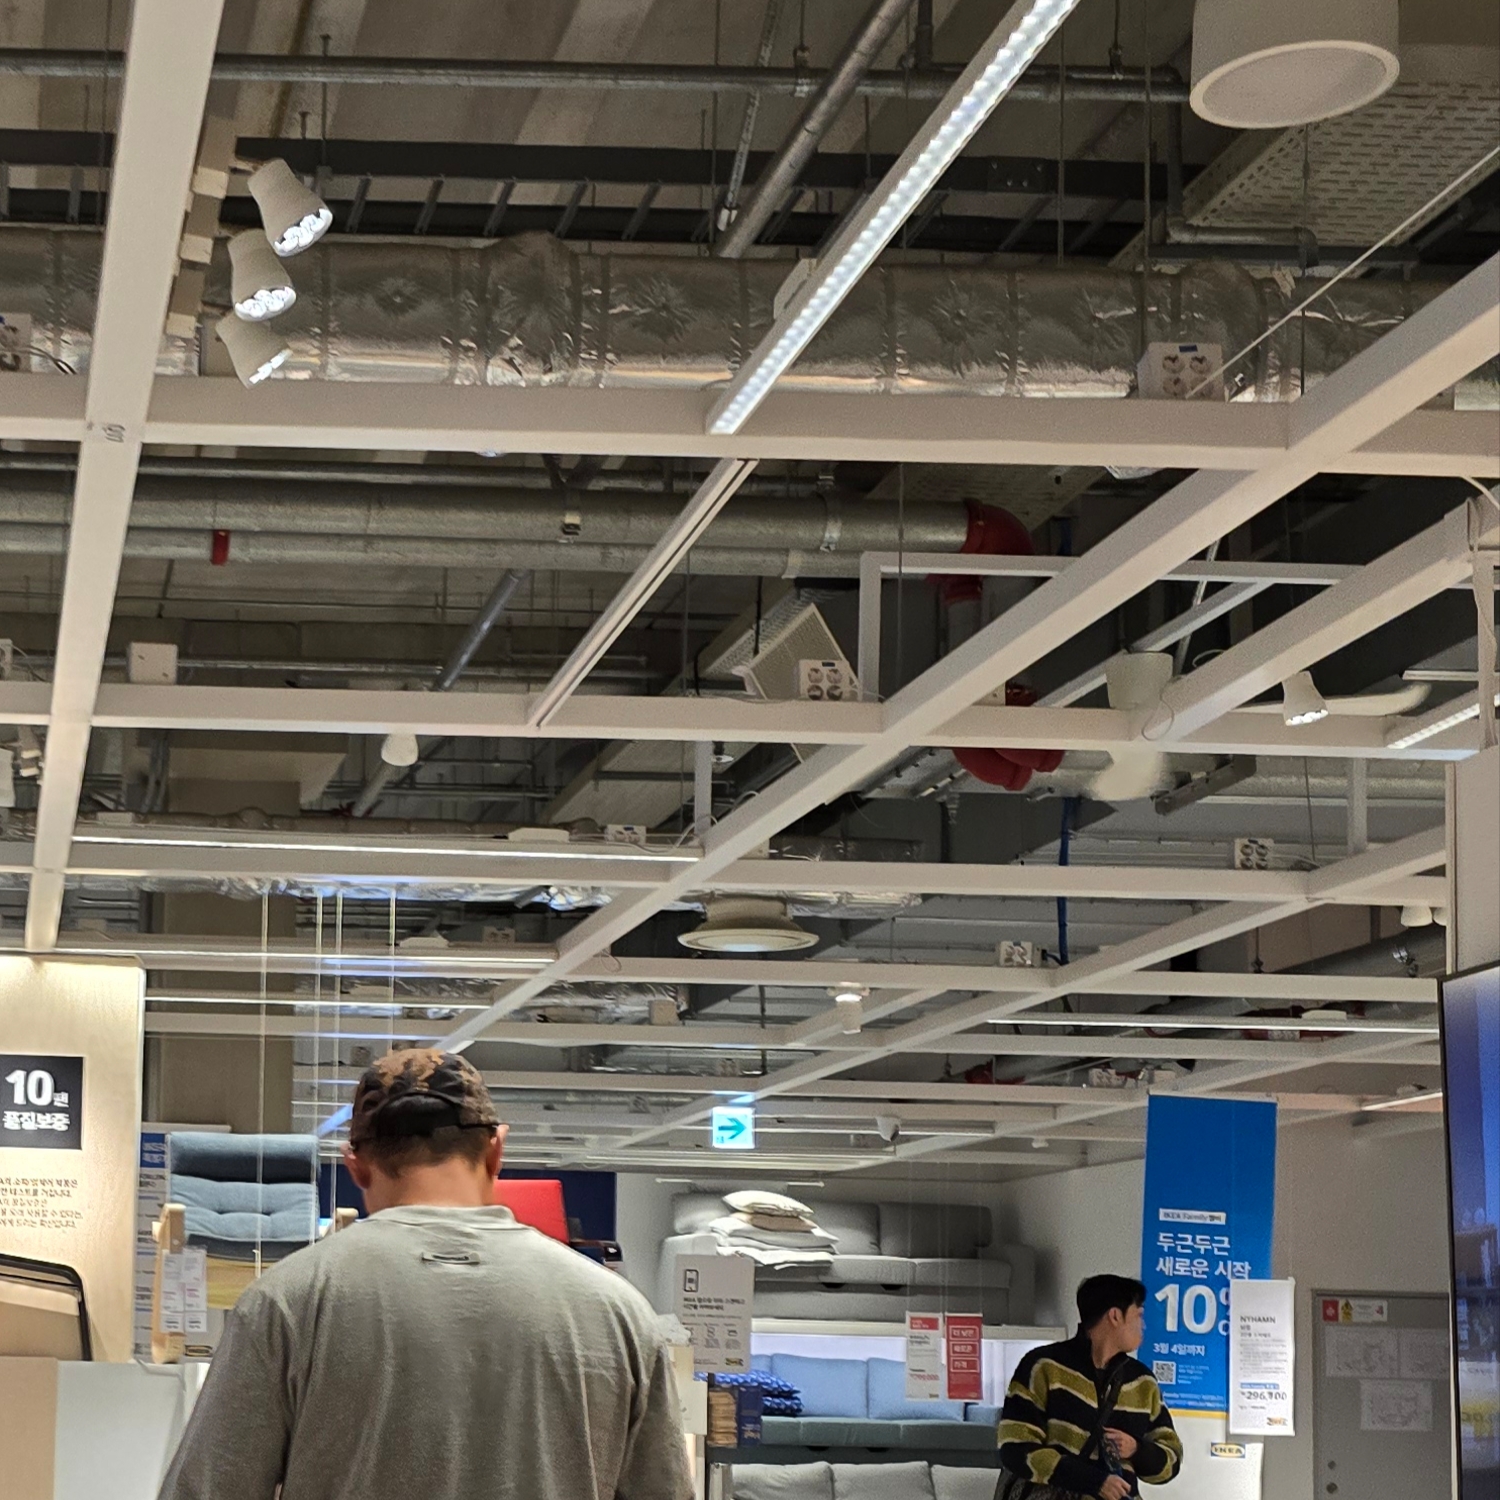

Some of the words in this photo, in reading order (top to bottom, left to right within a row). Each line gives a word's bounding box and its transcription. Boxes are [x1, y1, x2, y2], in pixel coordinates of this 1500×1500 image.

[2, 1111, 70, 1131] 품질보증
[1157, 1232, 1230, 1256] 두근두근
[1155, 1256, 1209, 1279] 새로운
[1214, 1260, 1251, 1280] 시작
[1240, 1316, 1276, 1324] NYHAMN
[1153, 1343, 1170, 1354] 3월
